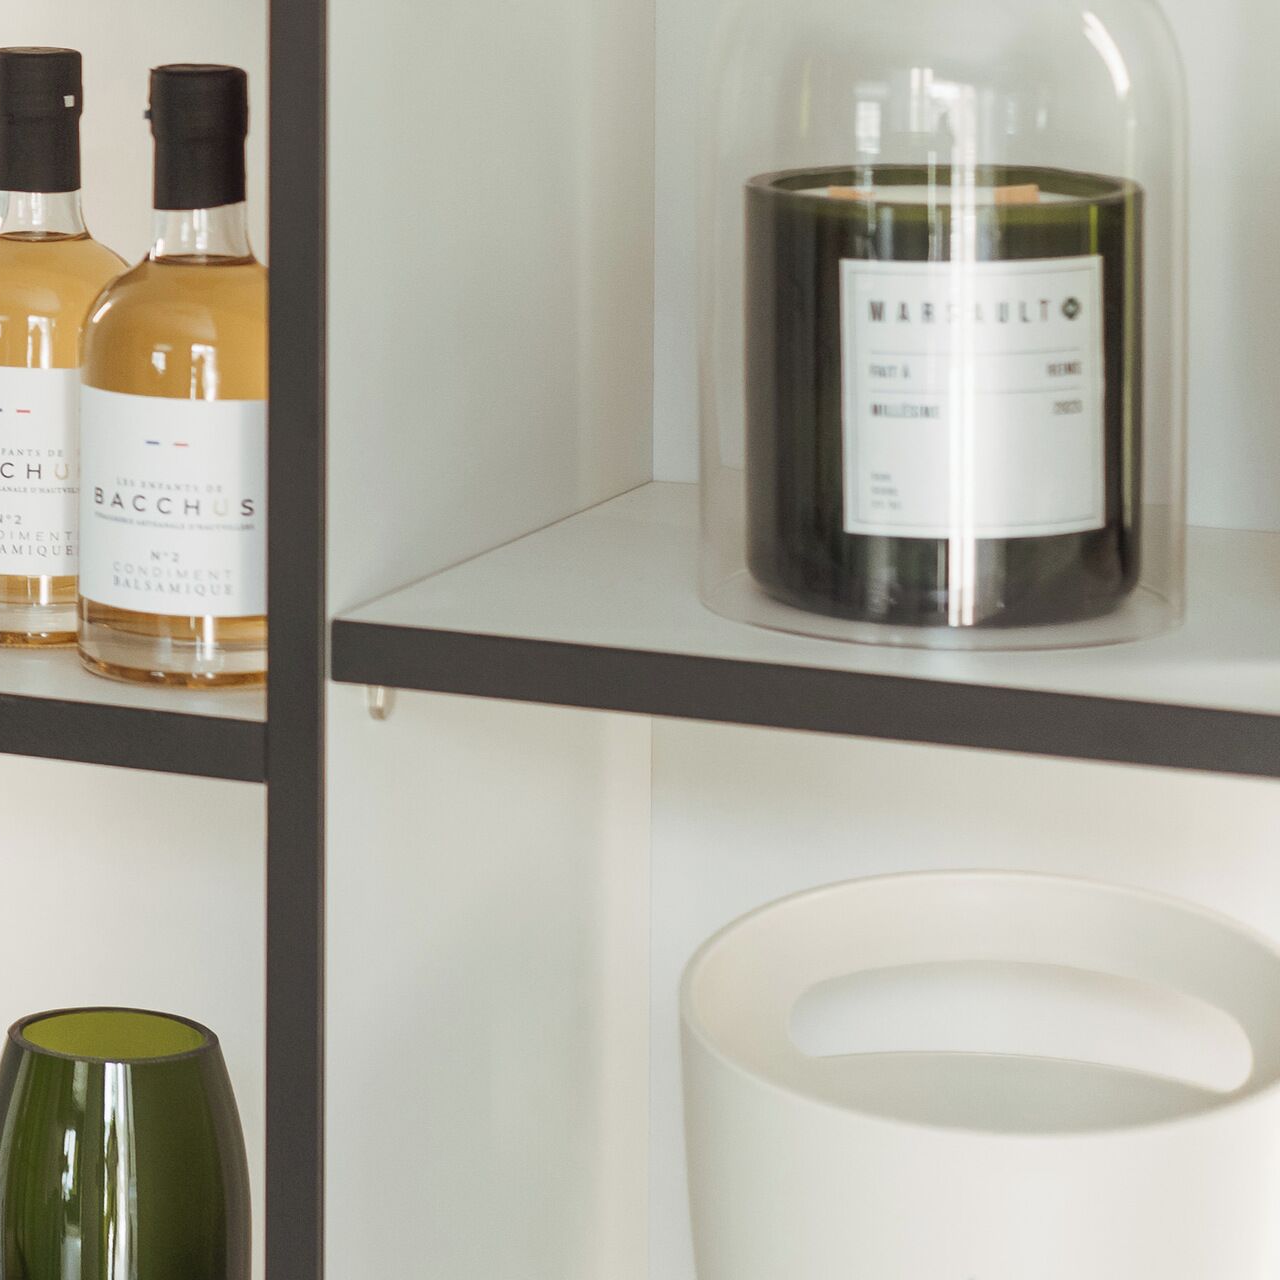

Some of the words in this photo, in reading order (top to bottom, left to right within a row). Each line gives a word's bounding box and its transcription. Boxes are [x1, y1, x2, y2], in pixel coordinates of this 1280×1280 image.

[48, 449, 64, 458] DE
[113, 562, 232, 581] CONDIMENT
[113, 575, 233, 597] BALSAMIQUE
